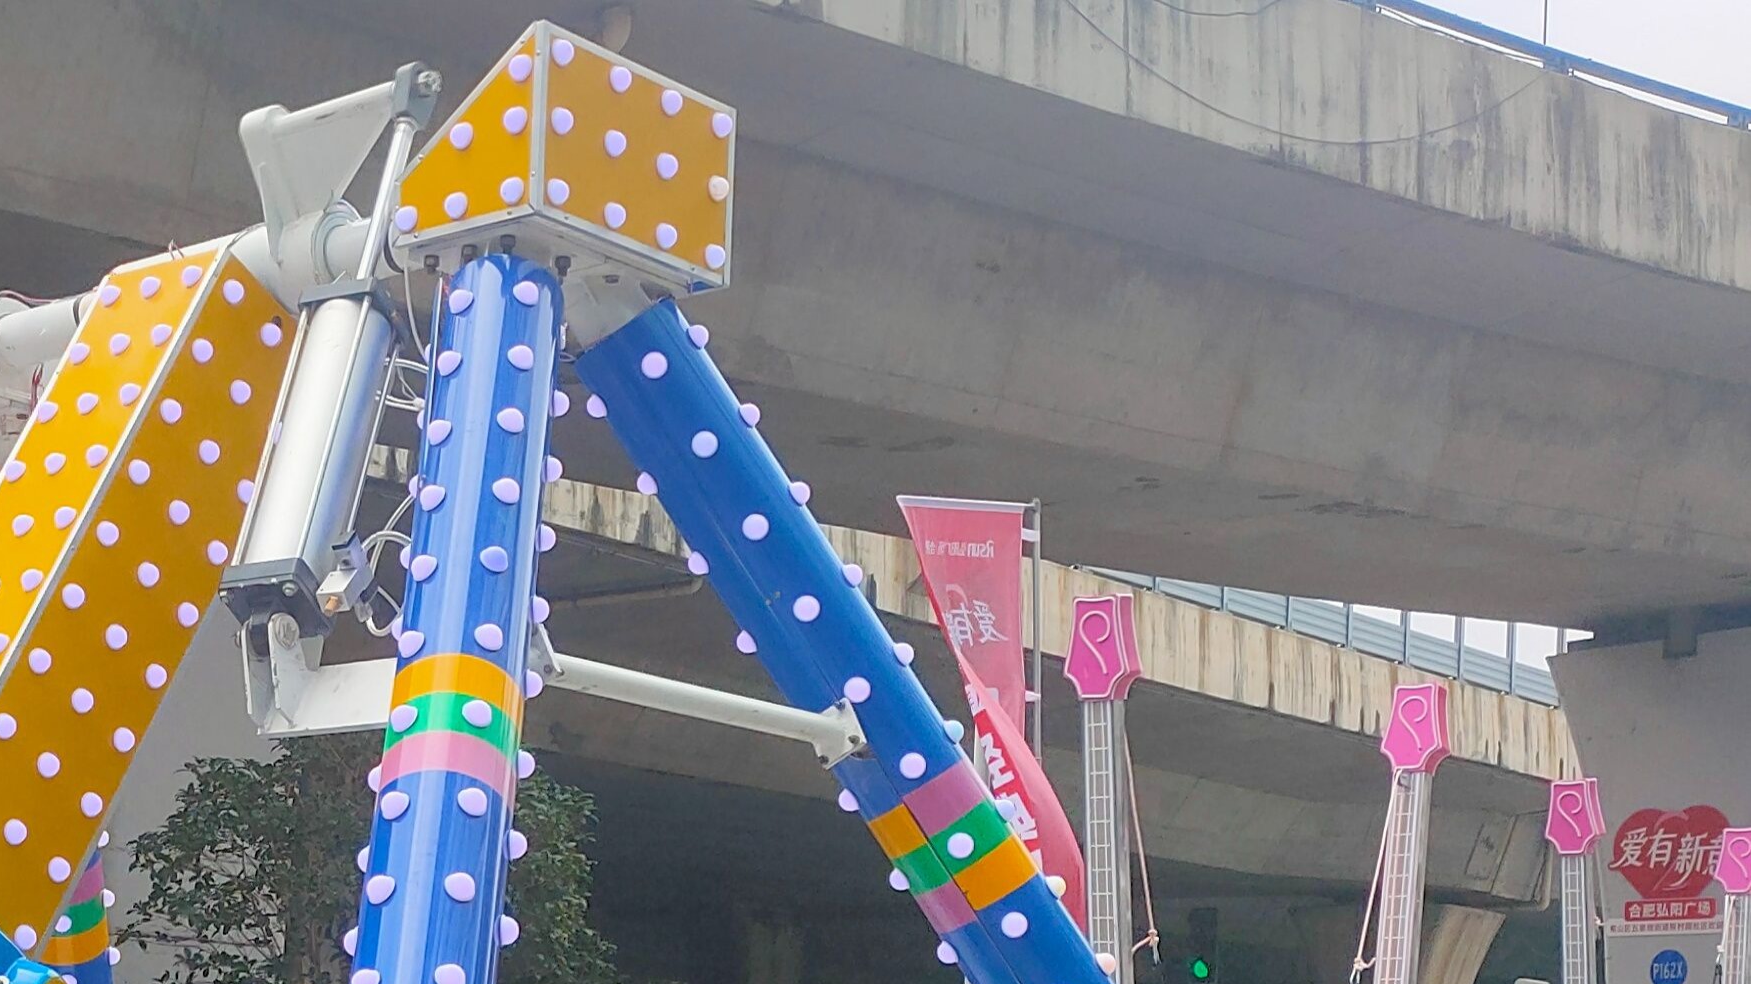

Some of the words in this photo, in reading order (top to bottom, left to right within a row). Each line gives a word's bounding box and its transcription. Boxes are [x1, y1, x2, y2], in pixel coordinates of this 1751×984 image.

[1629, 902, 1711, 918] 合肥弘阳广场
